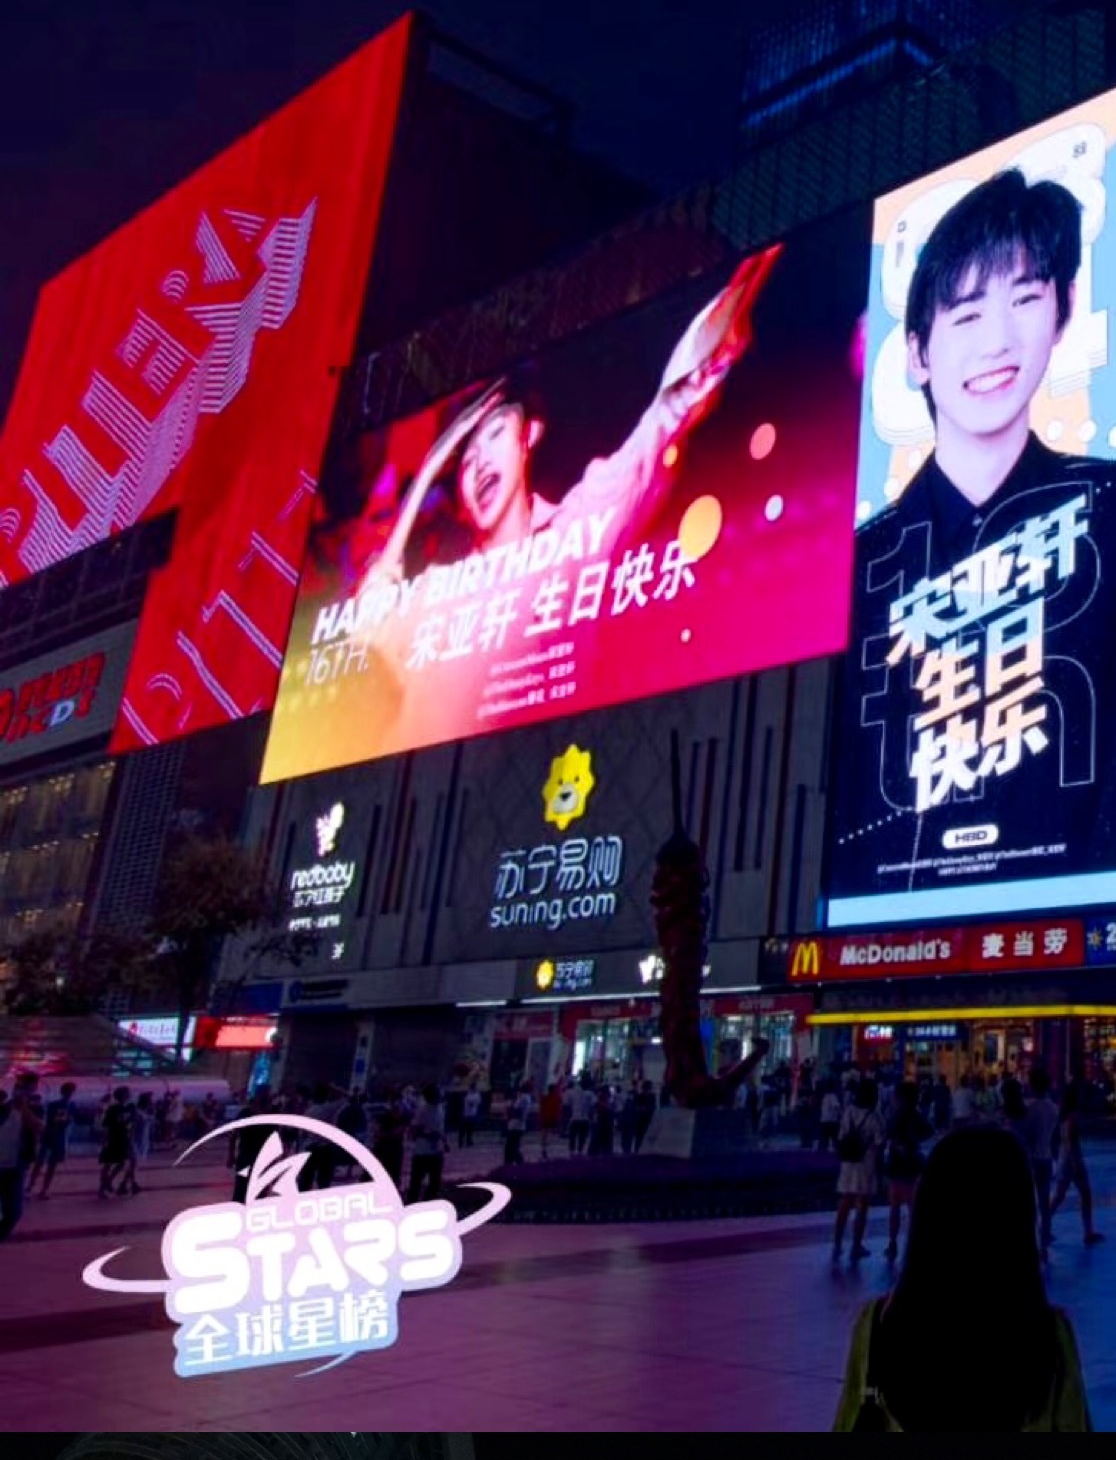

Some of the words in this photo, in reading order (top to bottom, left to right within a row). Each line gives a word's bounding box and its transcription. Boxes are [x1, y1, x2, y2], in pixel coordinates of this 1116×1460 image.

[312, 569, 418, 645] HAPPY
[423, 512, 617, 606] BIRTHDAY
[406, 598, 517, 670] 宋亚轩
[525, 541, 697, 636] 生日快乐
[886, 495, 1089, 667] 宋亚轩
[915, 596, 1045, 733] 生日
[909, 676, 1049, 814] 快乐
[490, 892, 616, 931] suning.com
[495, 835, 623, 900] 苏宁易购
[840, 937, 951, 966] McDonald's
[982, 928, 1067, 958] 麦当劳
